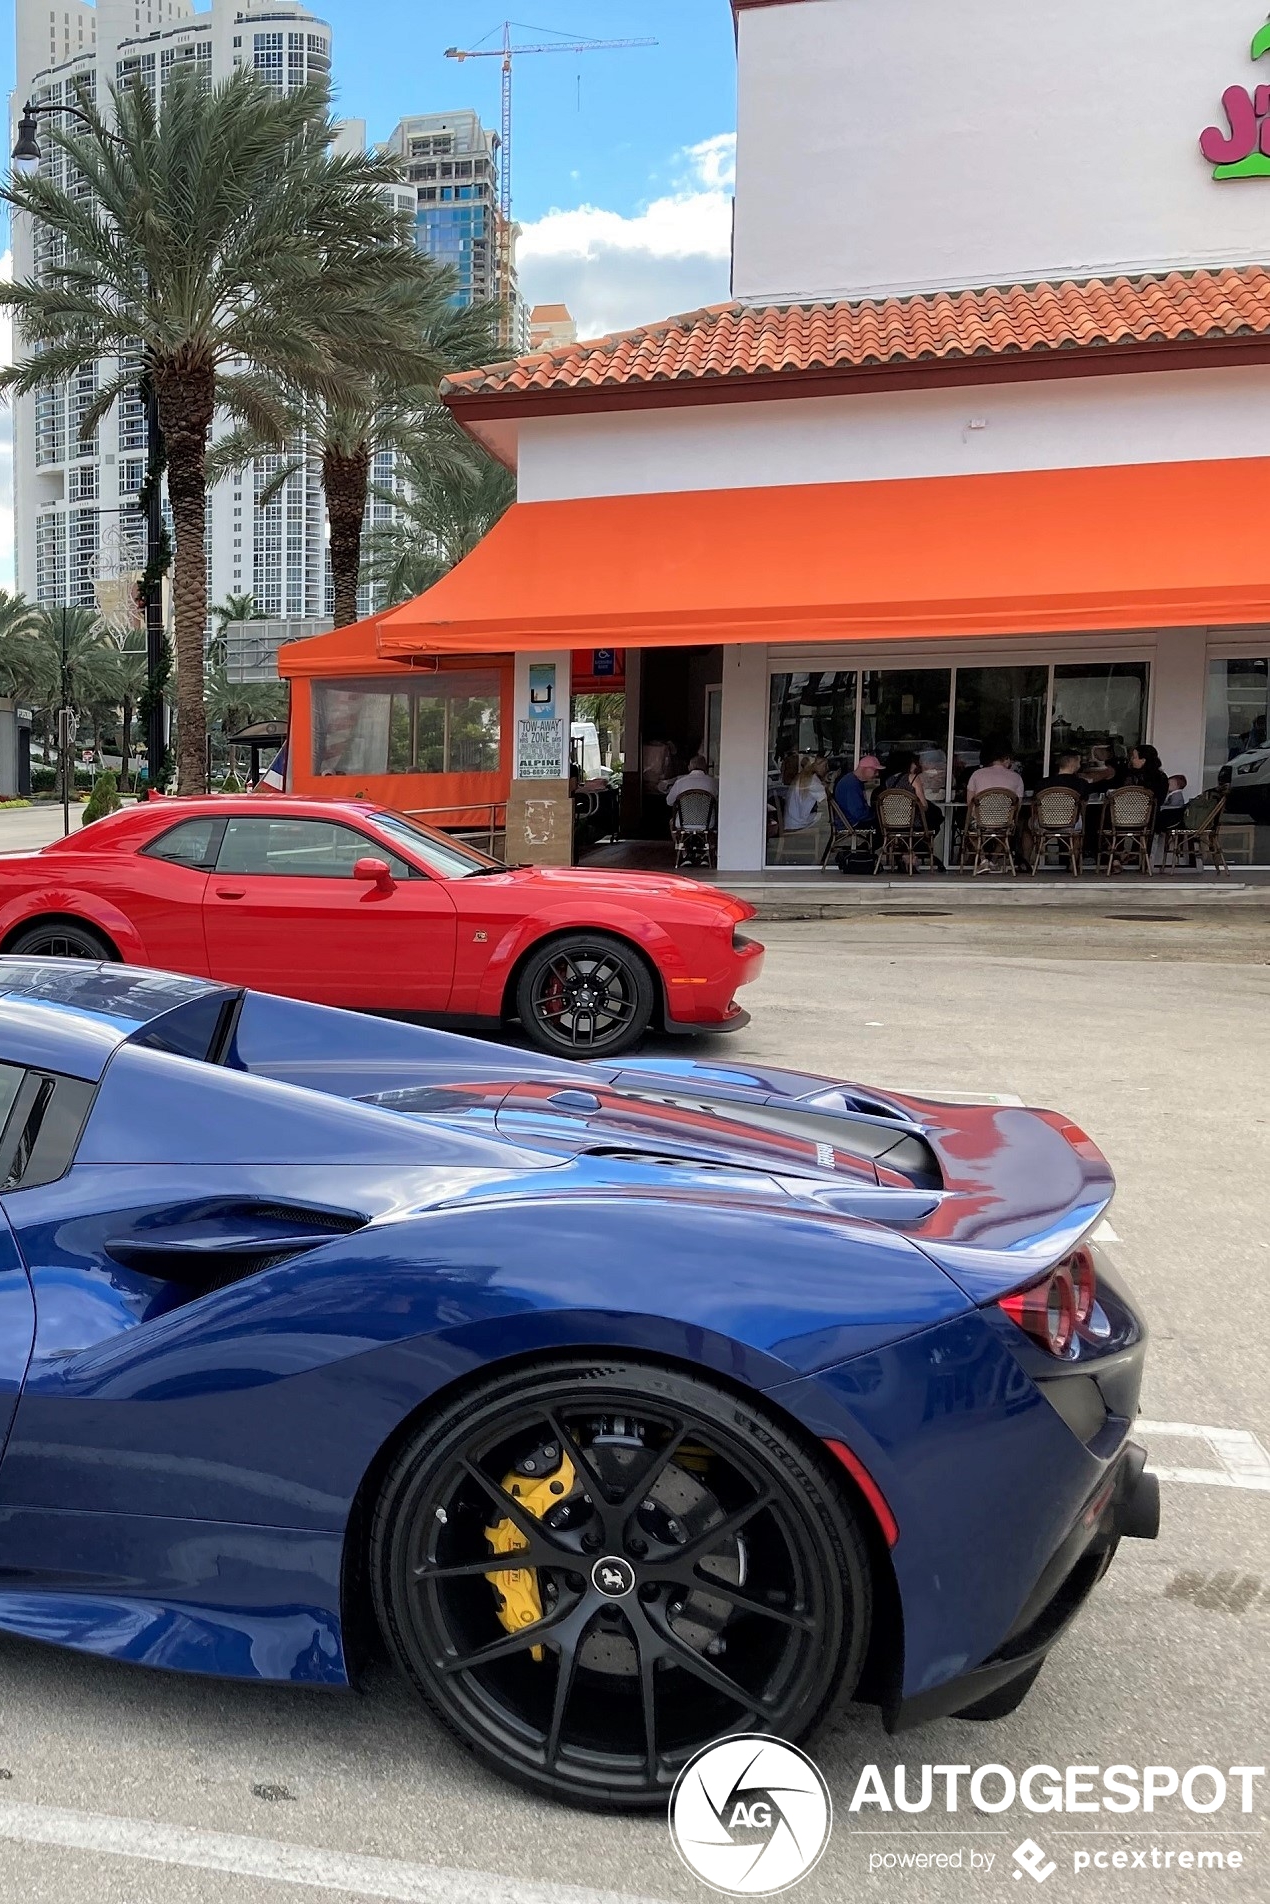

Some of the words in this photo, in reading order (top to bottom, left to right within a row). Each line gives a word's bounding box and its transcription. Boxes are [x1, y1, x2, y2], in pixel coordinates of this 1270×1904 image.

[522, 720, 559, 732] TOW-AWAY
[531, 731, 550, 743] ZONE
[751, 1429, 825, 1505] MICHELIN
